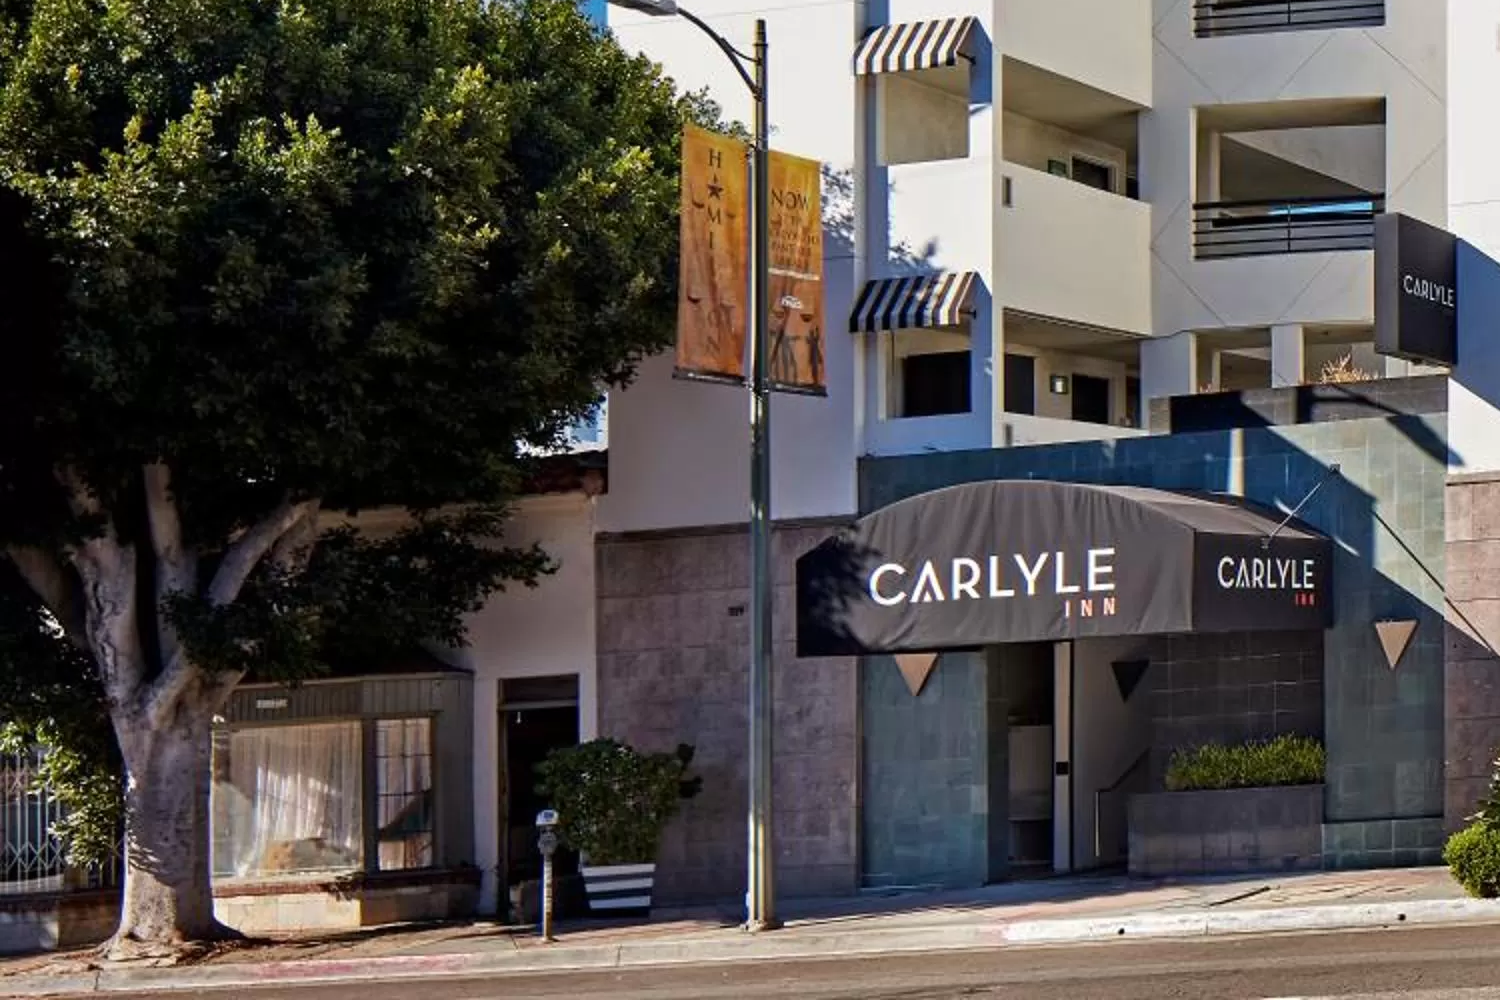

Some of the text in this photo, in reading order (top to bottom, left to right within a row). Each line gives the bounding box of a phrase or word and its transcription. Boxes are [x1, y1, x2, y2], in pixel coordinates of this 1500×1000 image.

[1403, 274, 1454, 307] CARLYLE
[869, 547, 1116, 606] CARLYLE
[1217, 556, 1316, 589] CARLYLE
[1065, 597, 1116, 618] INN
